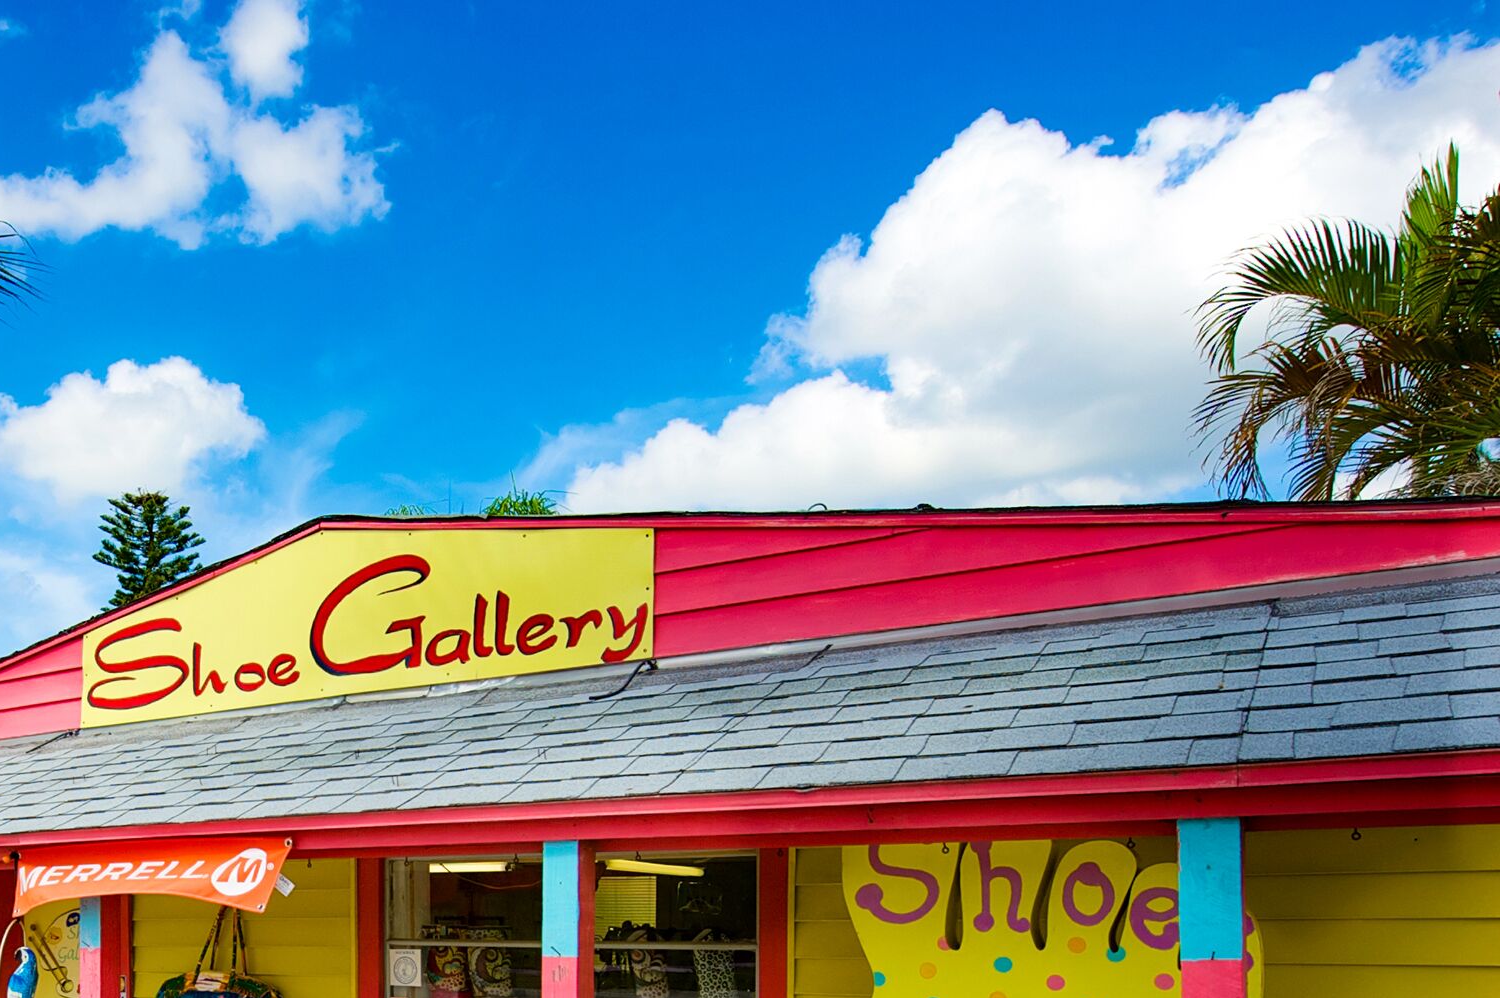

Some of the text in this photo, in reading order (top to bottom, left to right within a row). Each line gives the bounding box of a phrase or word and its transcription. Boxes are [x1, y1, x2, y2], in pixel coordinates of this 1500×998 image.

[87, 553, 648, 709] Shoe Gallery
[19, 860, 205, 896] MERRELL
[855, 840, 1255, 973] Shoe
